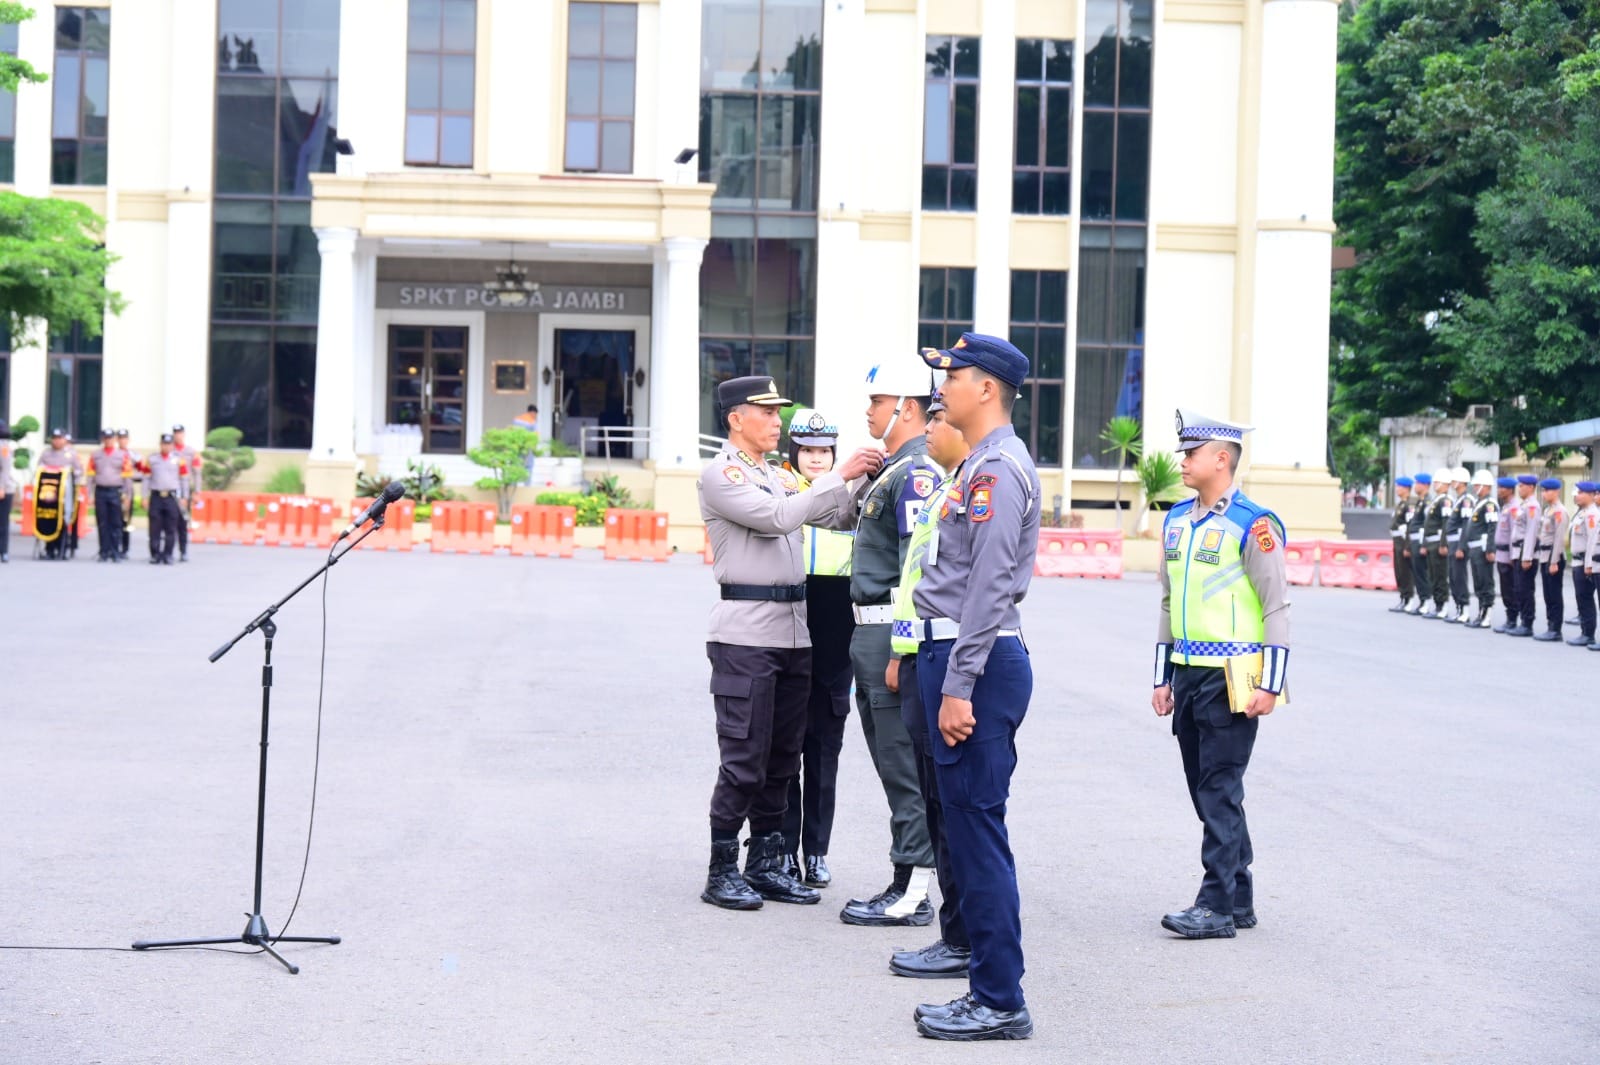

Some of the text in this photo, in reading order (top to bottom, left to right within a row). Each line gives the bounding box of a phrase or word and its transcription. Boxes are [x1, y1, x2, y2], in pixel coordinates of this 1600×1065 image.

[399, 287, 457, 305] SPKT
[552, 291, 625, 309] JAMBI
[1196, 552, 1218, 564] POLISI
